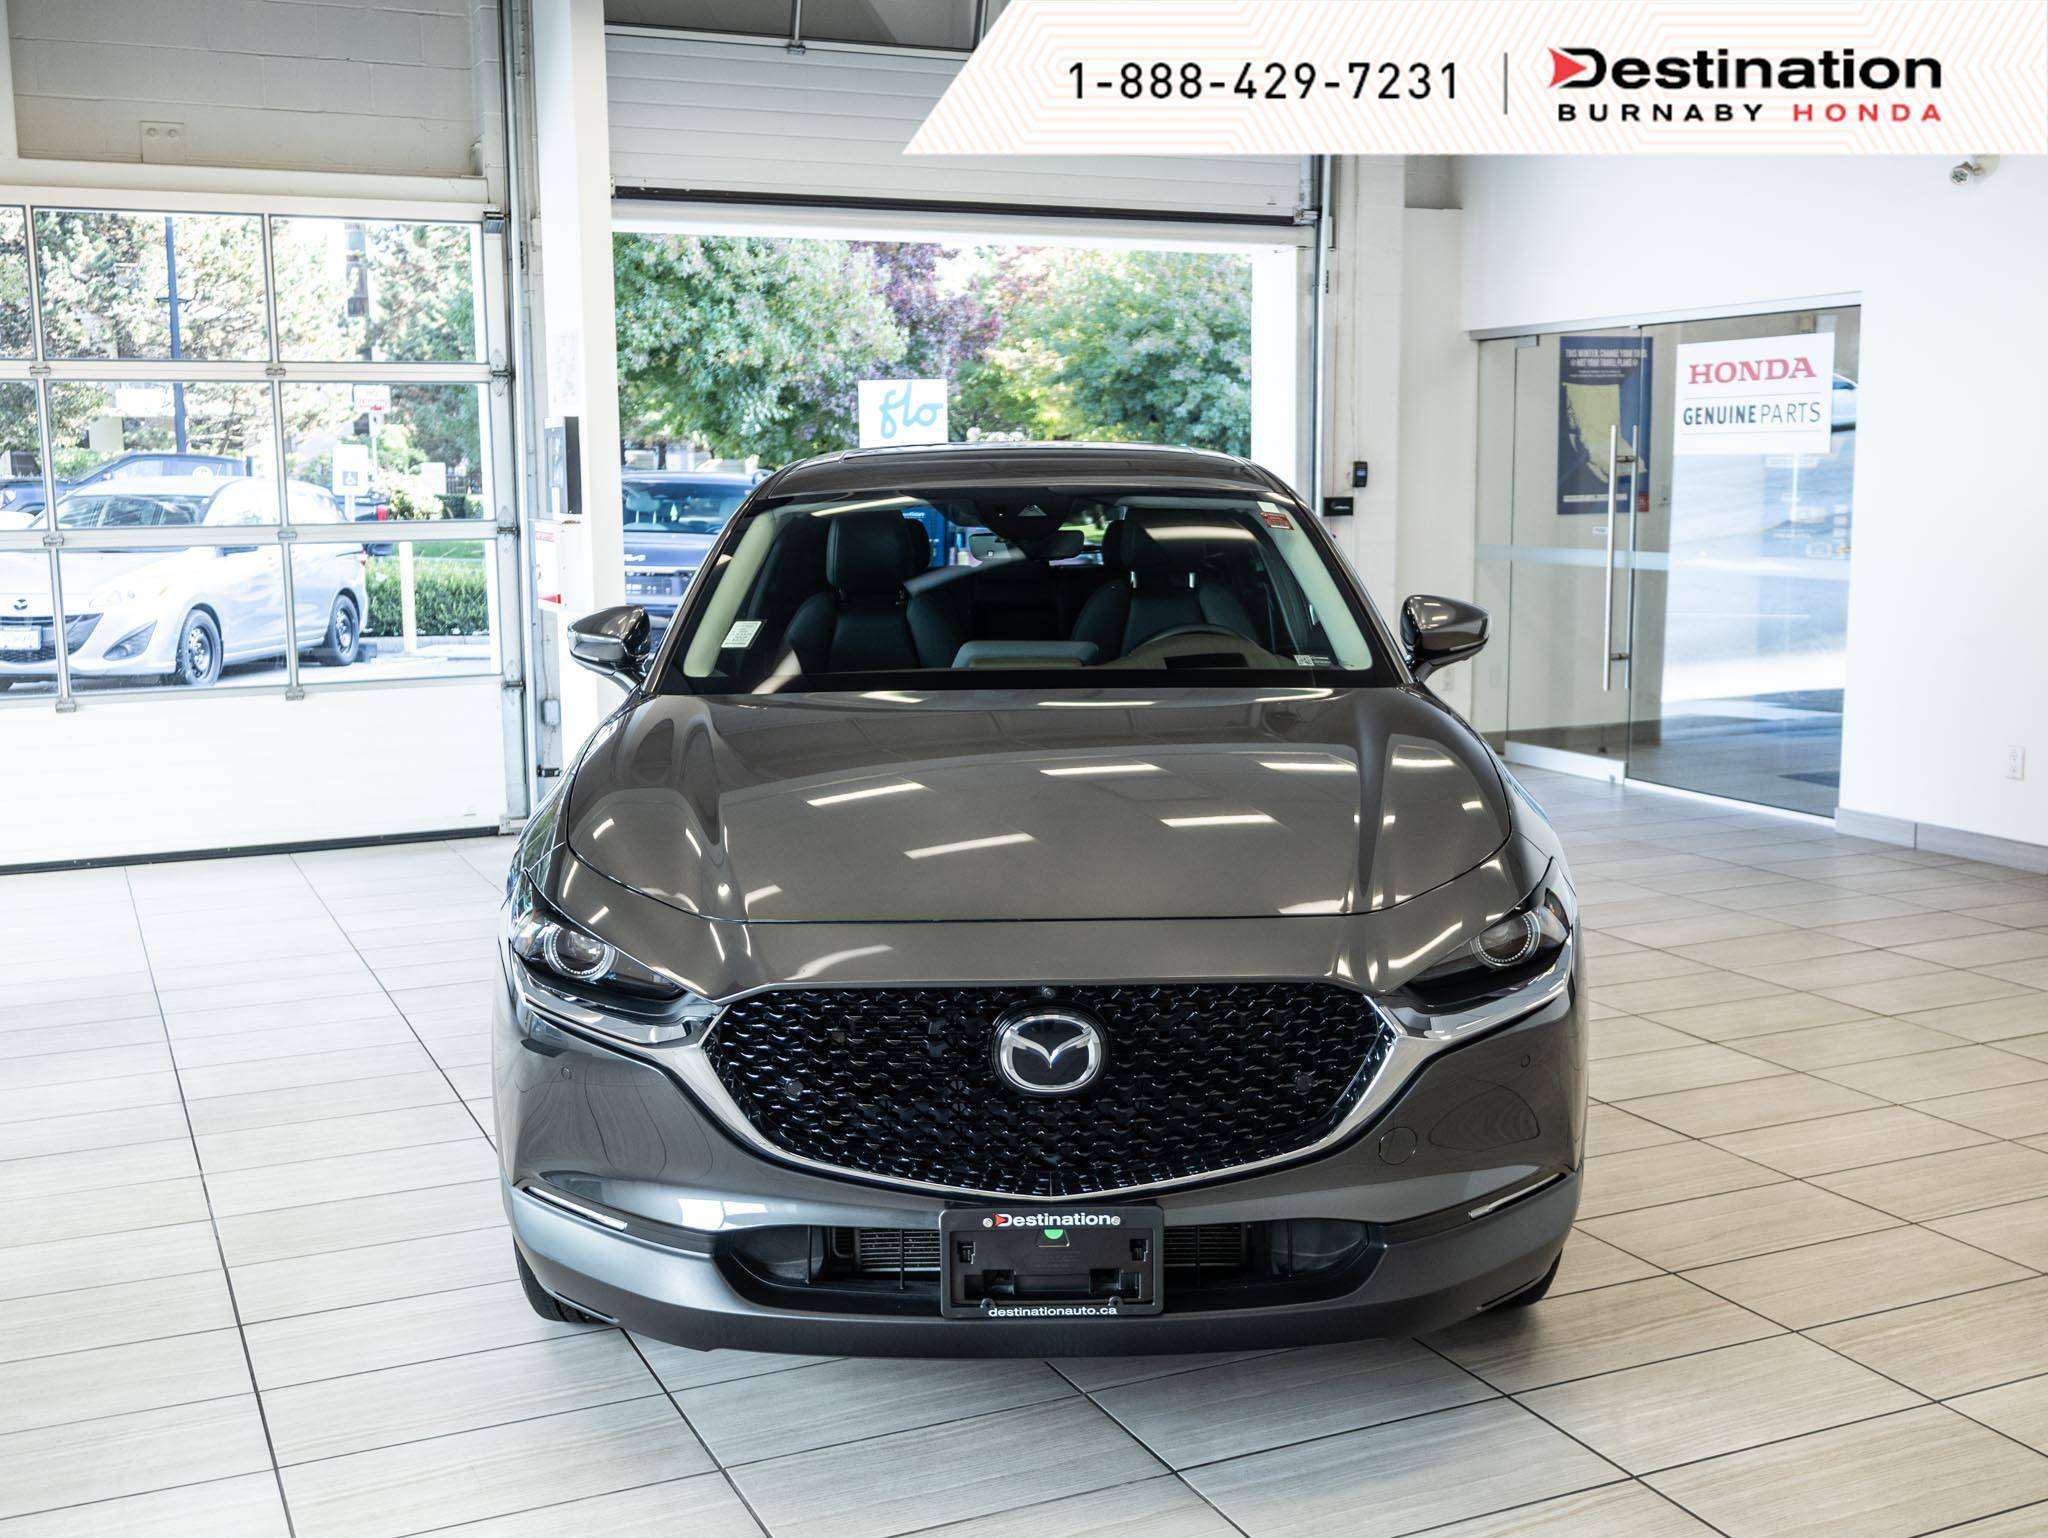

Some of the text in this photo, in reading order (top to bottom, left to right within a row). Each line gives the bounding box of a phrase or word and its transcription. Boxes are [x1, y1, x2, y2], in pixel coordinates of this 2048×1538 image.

[1688, 357, 1816, 384] HONDA
[879, 381, 944, 439] flo
[1683, 401, 1821, 425] GENUINE PARTS
[993, 1212, 1111, 1227] Destination
[988, 1305, 1118, 1317] destinationauto.ca
